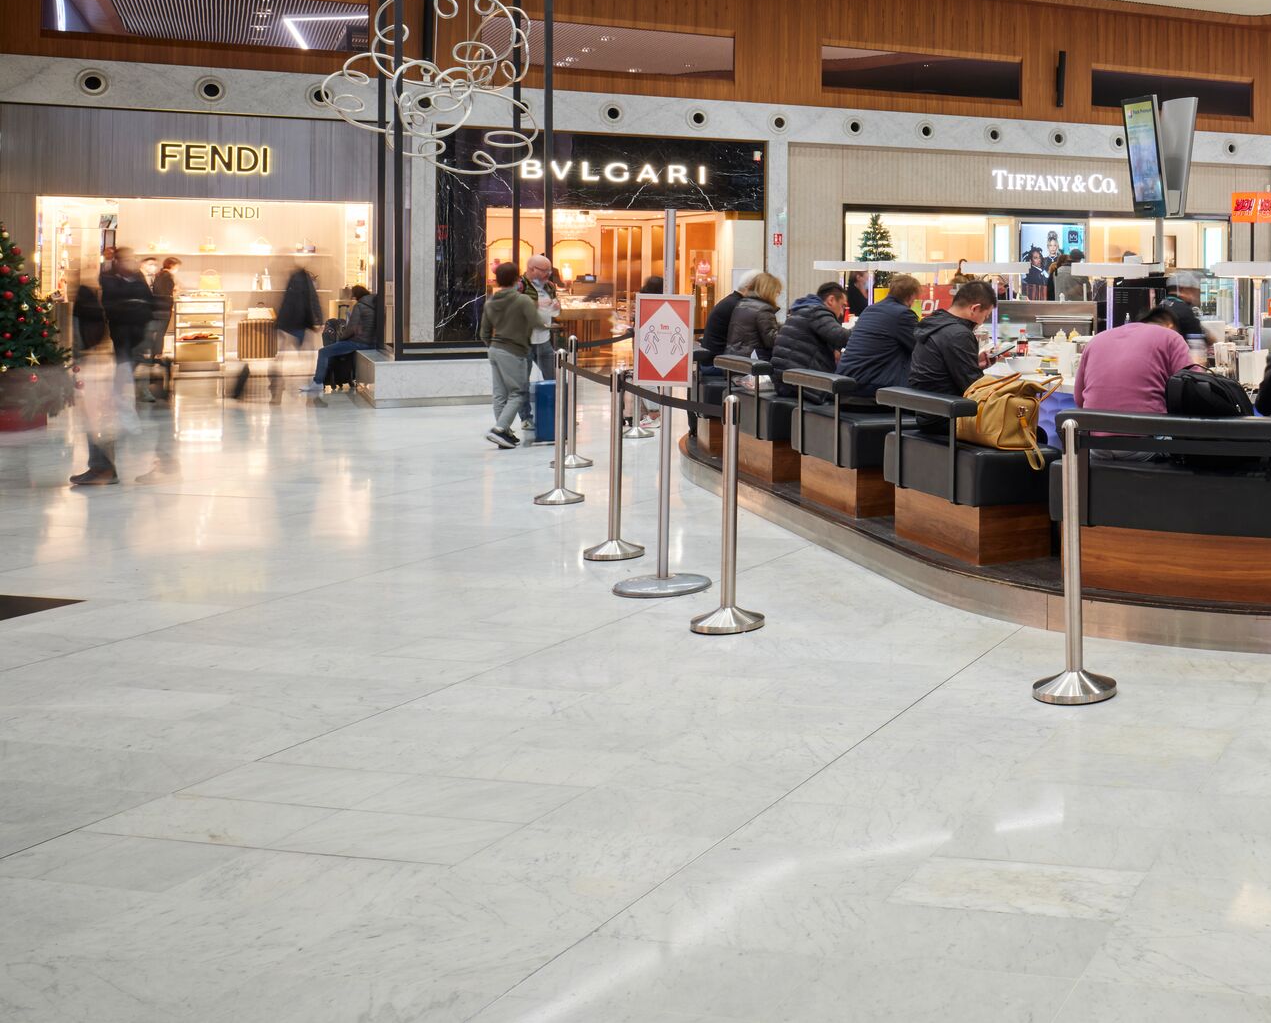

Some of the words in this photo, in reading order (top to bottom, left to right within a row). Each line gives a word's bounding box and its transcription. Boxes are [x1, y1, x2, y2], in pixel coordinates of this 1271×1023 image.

[160, 142, 269, 174] FENDI
[520, 159, 707, 185] BVLGARI
[210, 205, 260, 219] FENDI
